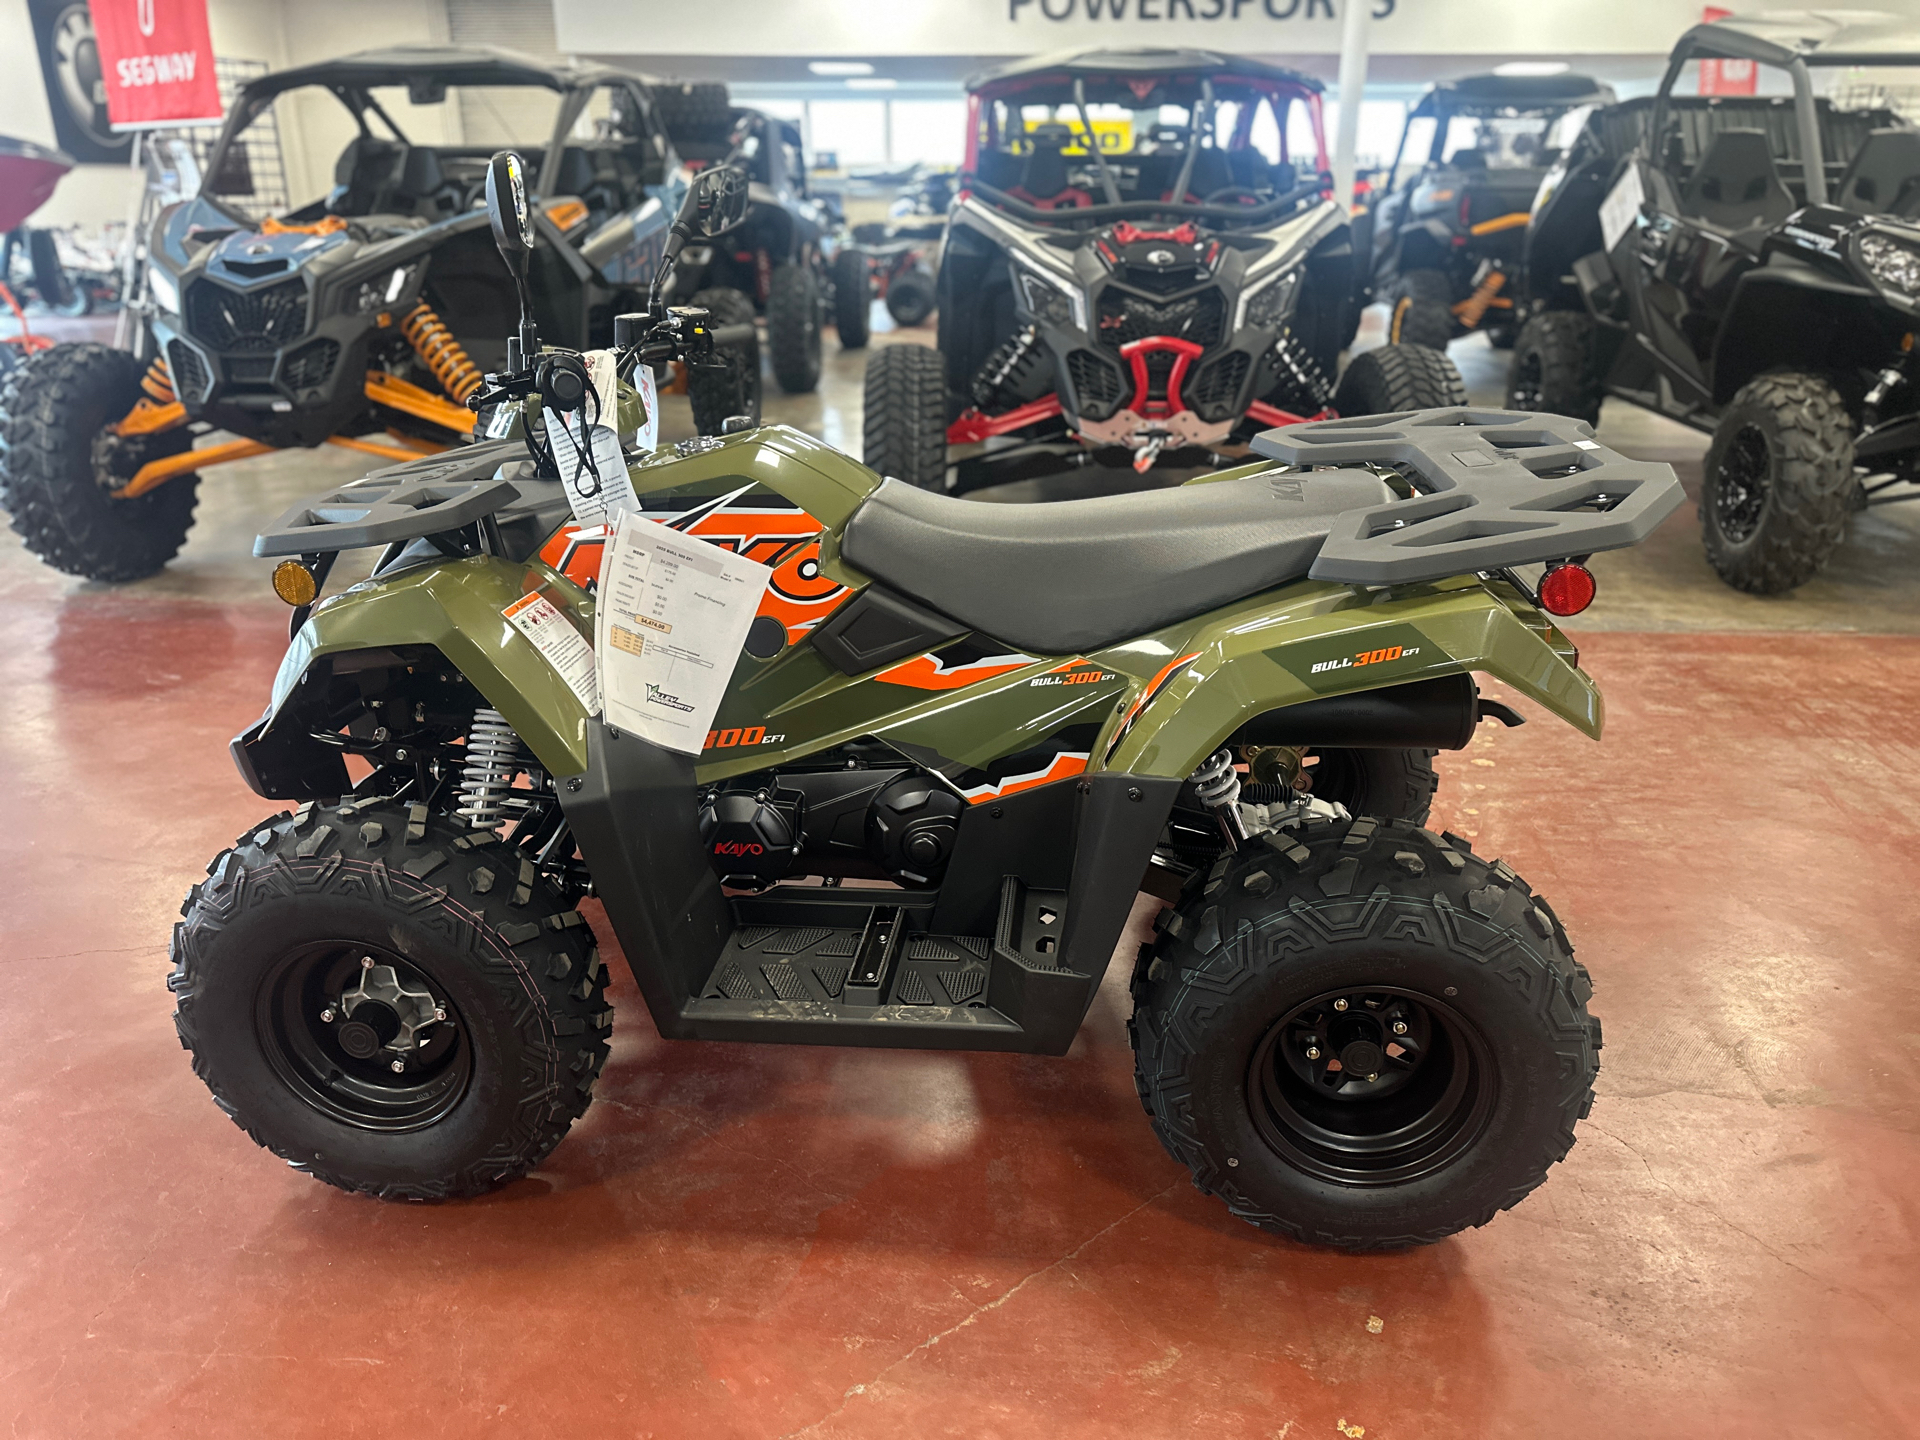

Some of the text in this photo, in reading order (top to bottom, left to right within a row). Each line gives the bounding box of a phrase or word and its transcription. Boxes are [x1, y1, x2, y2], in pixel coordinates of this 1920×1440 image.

[117, 51, 197, 87] SEGWAY
[706, 595, 726, 607] Financing
[641, 617, 666, 630] $4,474.00
[1311, 646, 1420, 674] BULL 300 EFI
[1030, 676, 1062, 687] BULL
[1063, 671, 1103, 686] 300
[761, 734, 786, 744] EFI
[714, 840, 763, 857] KAYO
